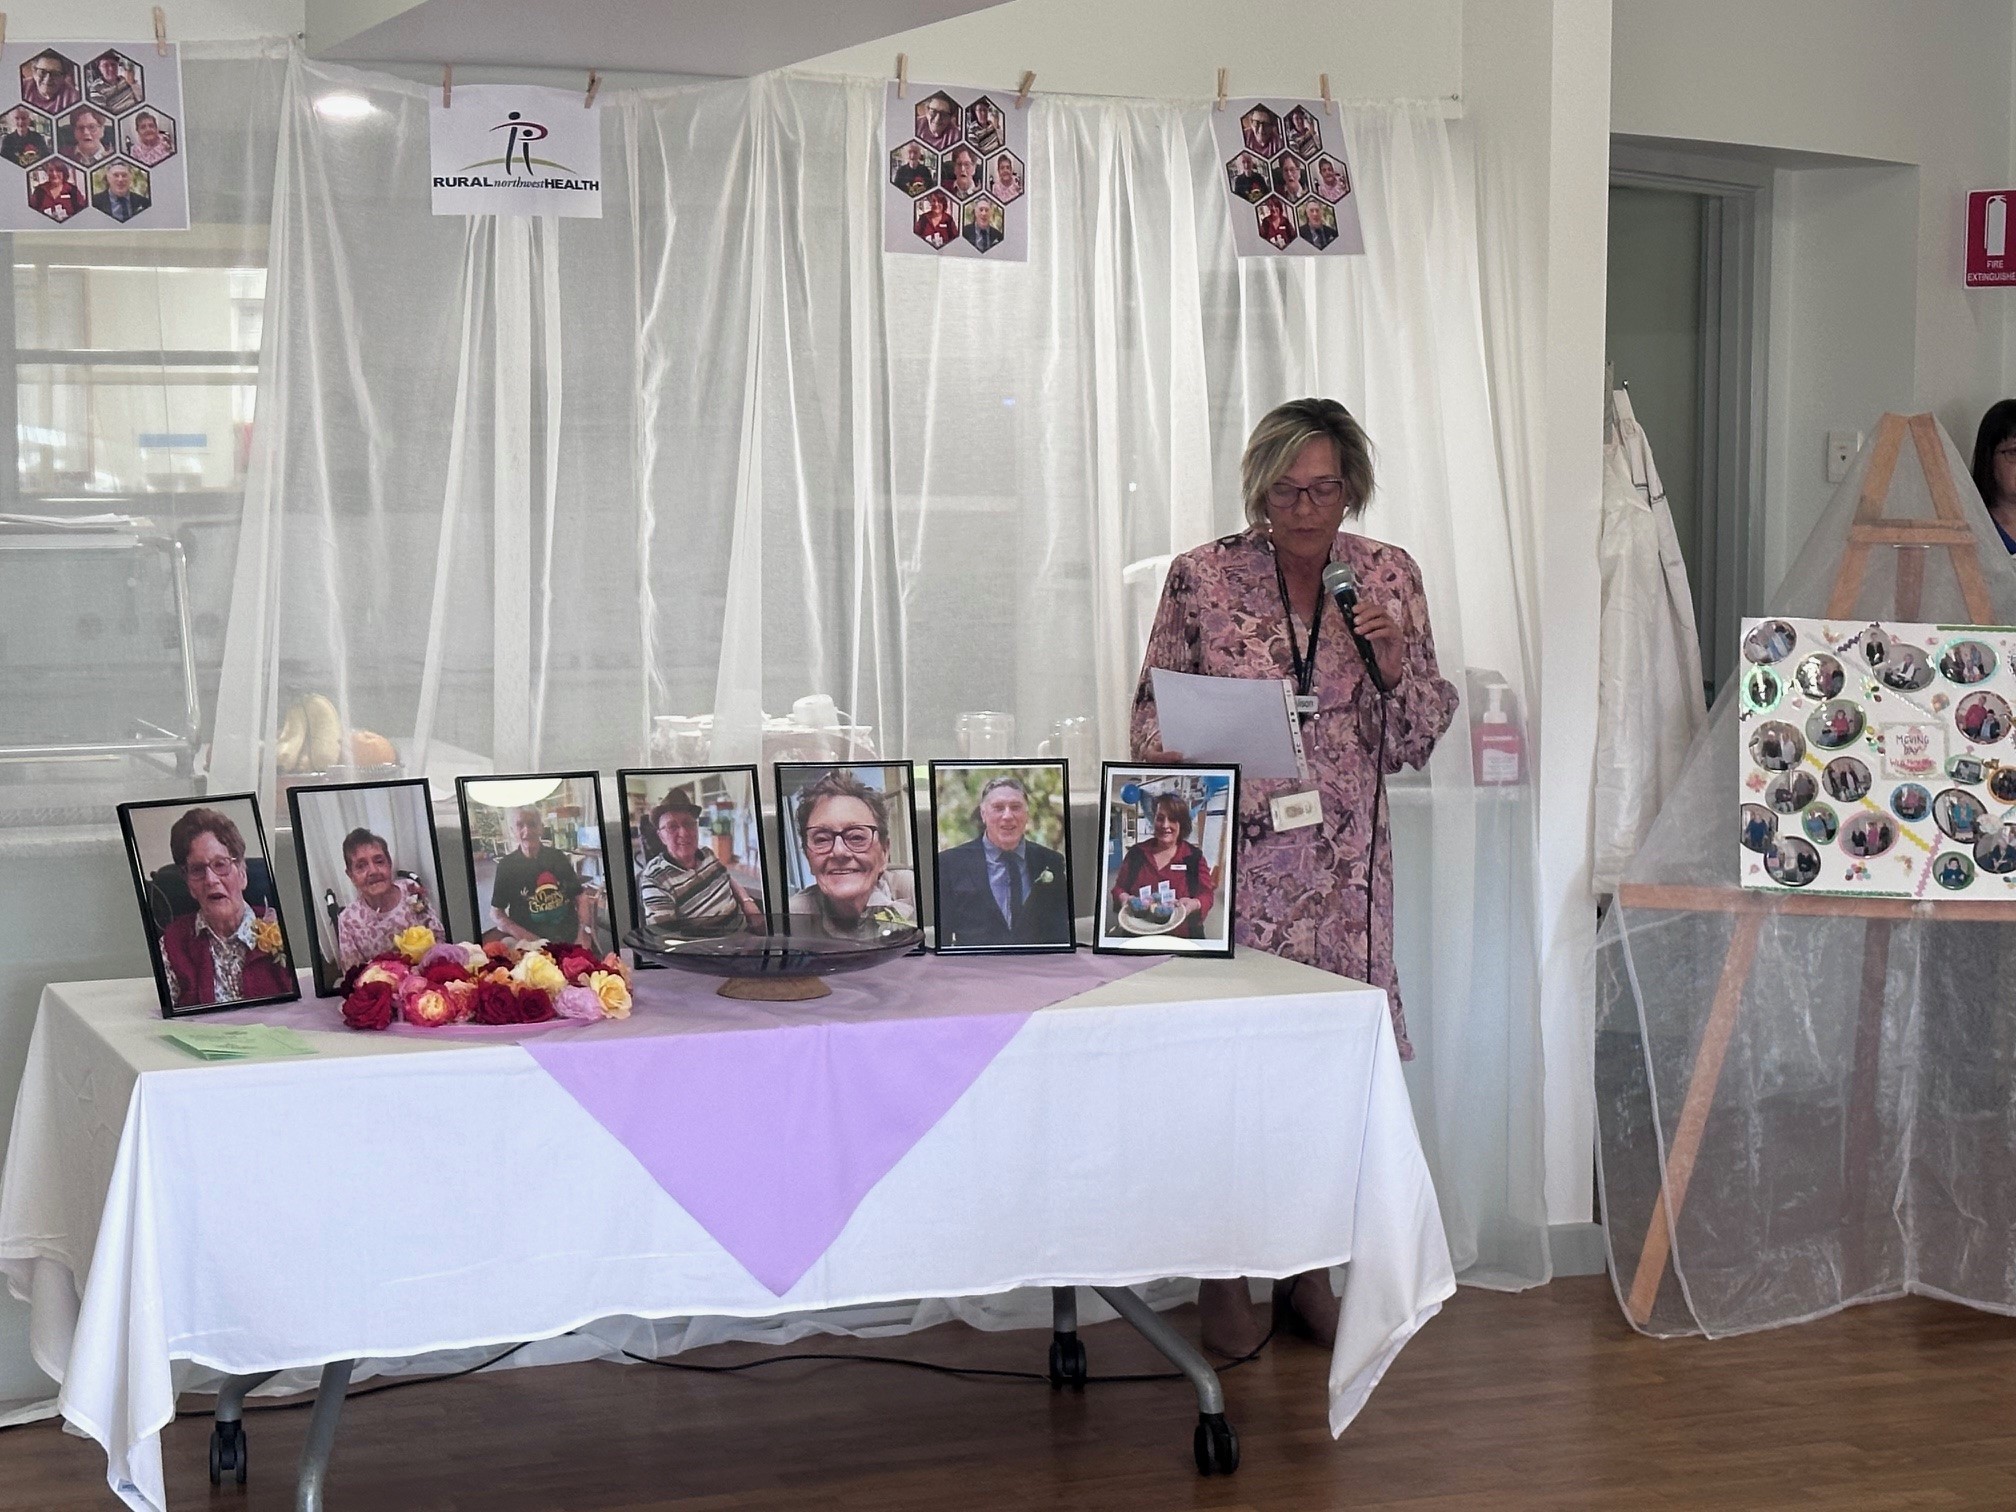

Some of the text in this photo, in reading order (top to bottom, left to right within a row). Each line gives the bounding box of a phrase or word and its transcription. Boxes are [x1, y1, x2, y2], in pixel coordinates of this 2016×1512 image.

[1986, 260, 2004, 269] FIRE
[1967, 272, 2016, 282] EXTINGUISHE
[1896, 735, 1930, 745] MOVING
[1903, 744, 1920, 755] DAY
